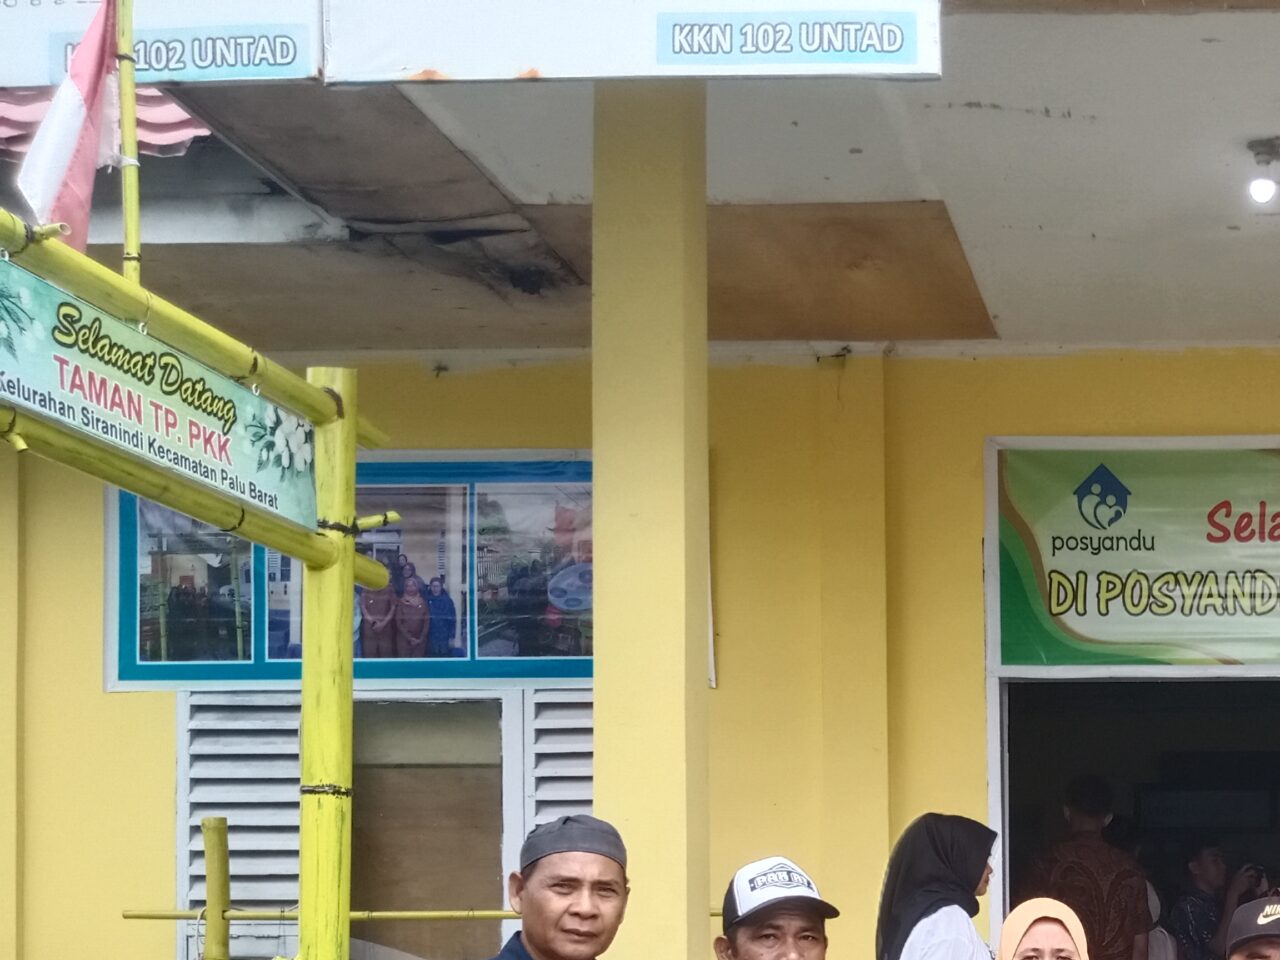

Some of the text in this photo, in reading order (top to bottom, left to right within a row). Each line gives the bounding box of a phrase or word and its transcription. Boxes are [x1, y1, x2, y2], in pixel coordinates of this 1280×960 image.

[190, 36, 296, 68] UNTAD
[672, 22, 904, 54] KKN 102 UNTAD
[52, 302, 237, 436] Selamat Datang
[53, 354, 233, 466] TAMAN TP. PKK
[81, 406, 144, 451] Siranindi
[148, 435, 217, 483] Kecamatan
[220, 468, 245, 495] Palu
[248, 481, 279, 510] Barat
[1052, 529, 1155, 556] posyandu
[1048, 569, 1087, 616] DI
